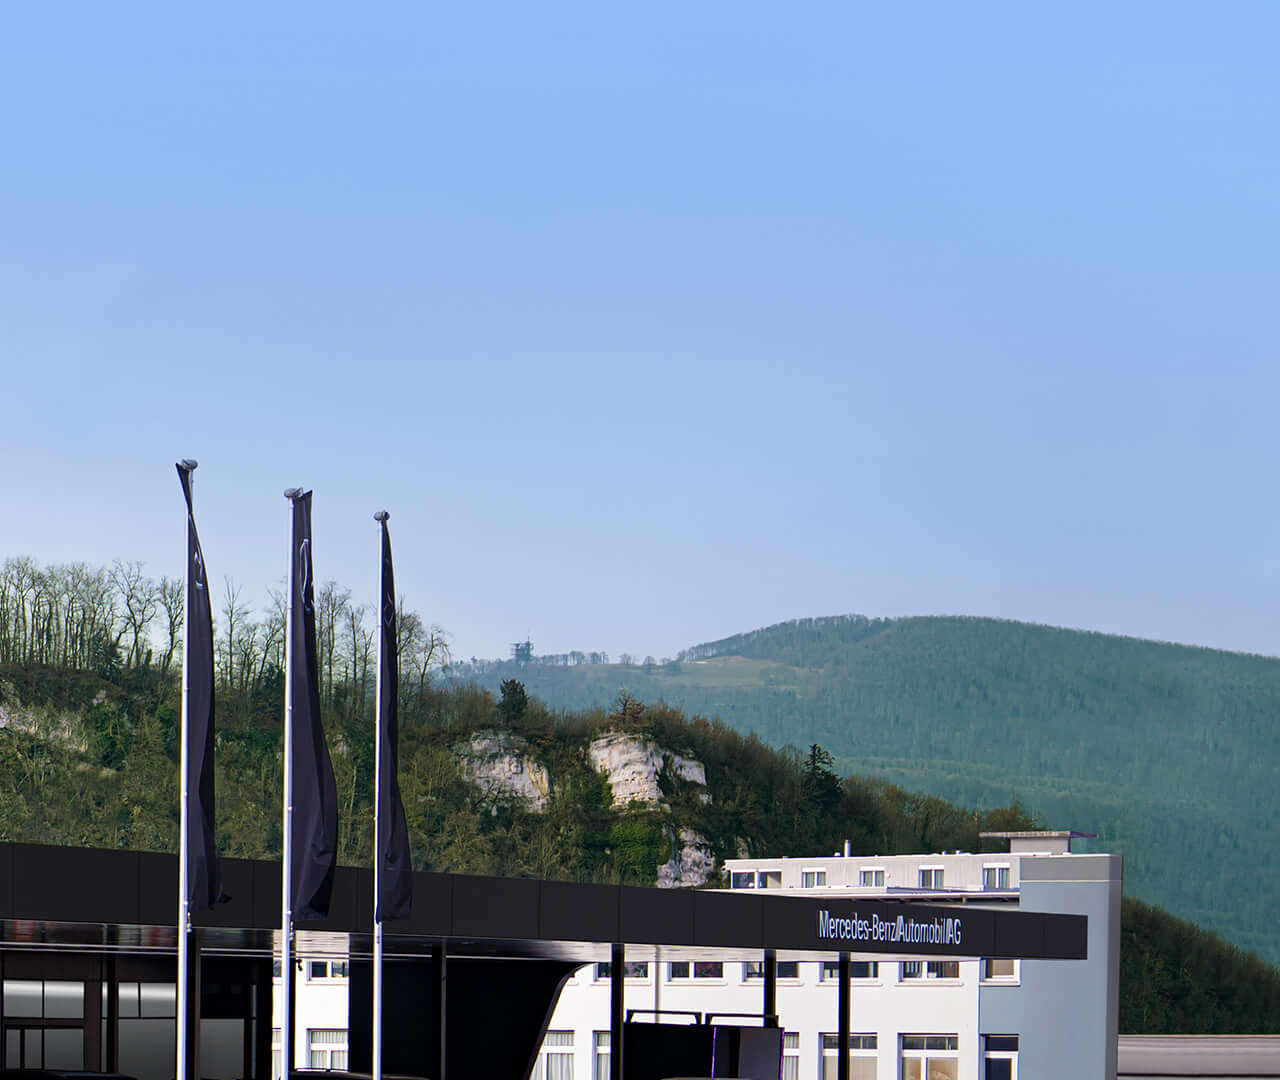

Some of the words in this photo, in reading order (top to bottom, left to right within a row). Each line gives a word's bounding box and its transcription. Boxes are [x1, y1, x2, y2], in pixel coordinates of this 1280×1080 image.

[819, 909, 897, 942] Mercedes-Benz
[897, 915, 947, 944] Automobil
[946, 918, 962, 945] AG
